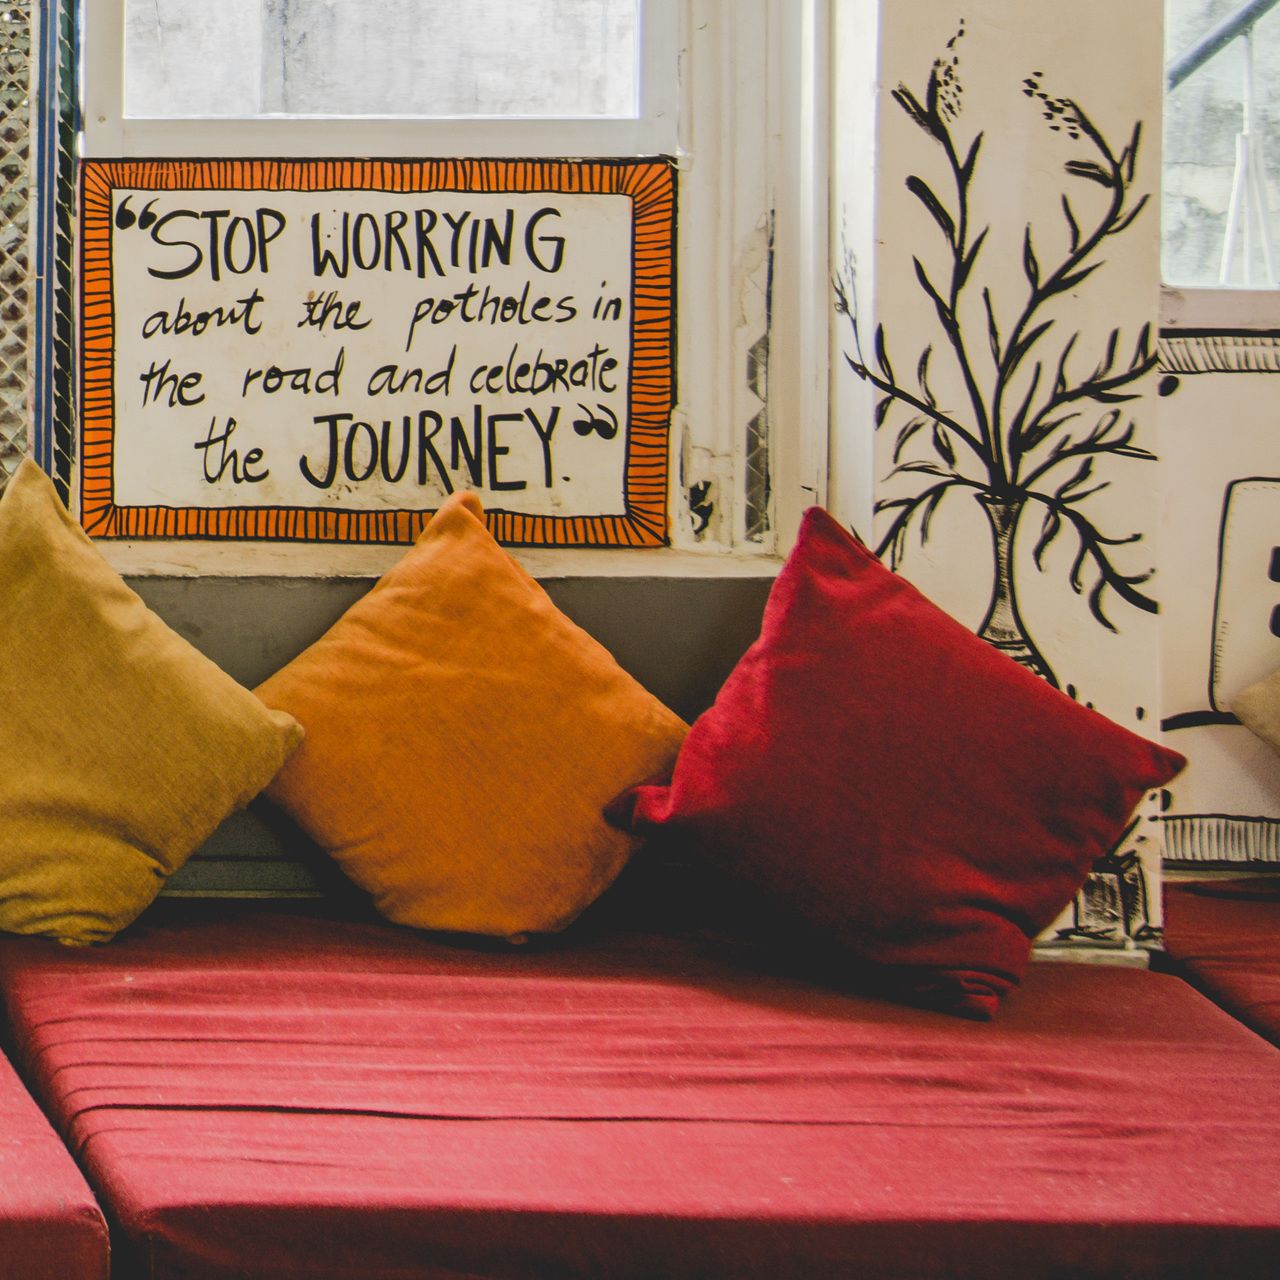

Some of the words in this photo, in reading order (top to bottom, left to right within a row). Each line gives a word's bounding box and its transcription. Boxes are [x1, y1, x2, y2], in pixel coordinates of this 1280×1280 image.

[311, 208, 565, 279] WORRYING
[142, 288, 264, 339] about
[297, 290, 373, 331] the
[405, 280, 577, 352] potholes
[593, 280, 621, 321] in
[140, 358, 205, 408] the
[242, 346, 344, 398] road
[367, 344, 456, 396] and
[469, 343, 618, 396] celebrate
[194, 416, 269, 484] the
